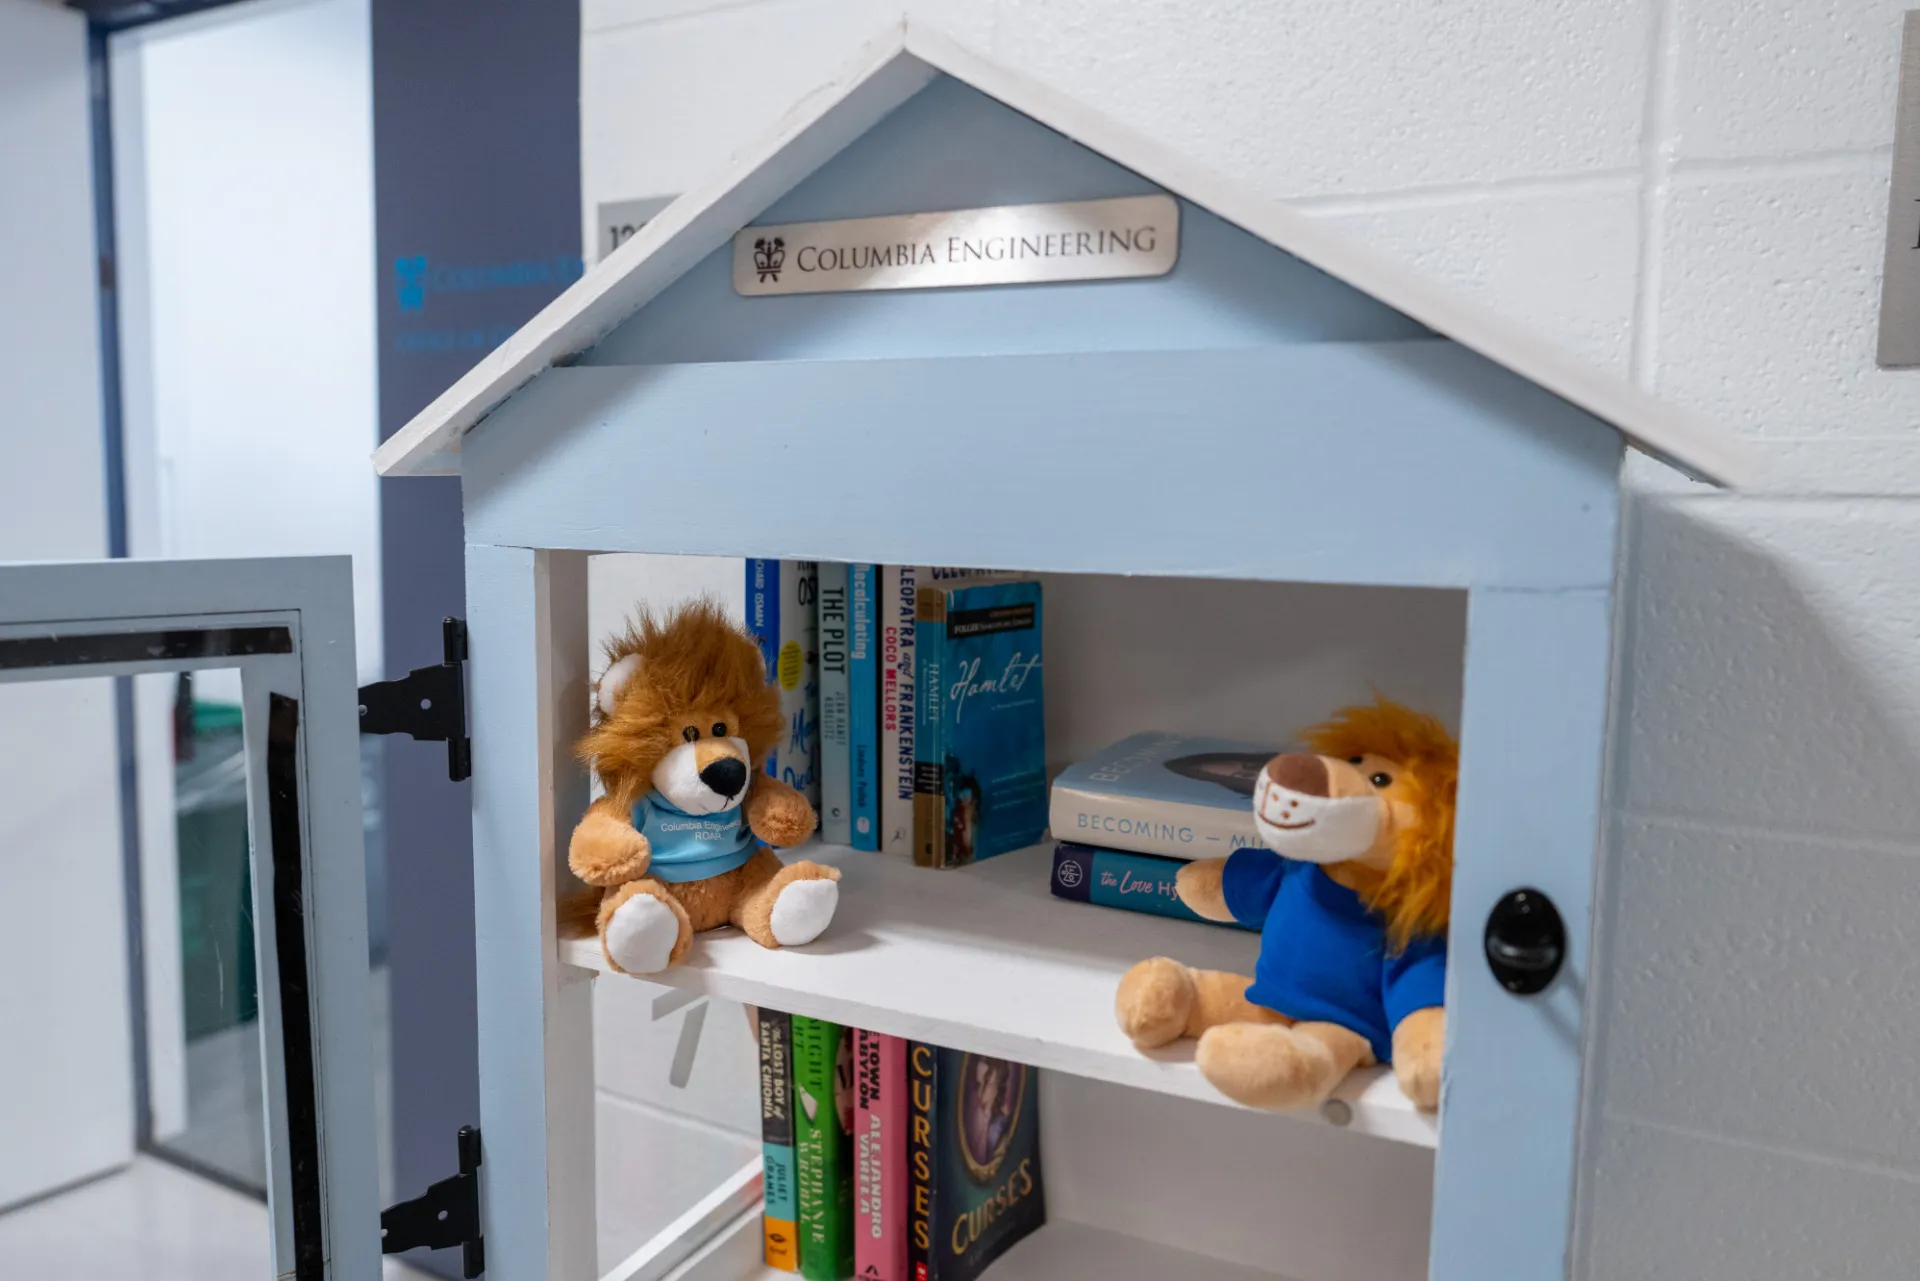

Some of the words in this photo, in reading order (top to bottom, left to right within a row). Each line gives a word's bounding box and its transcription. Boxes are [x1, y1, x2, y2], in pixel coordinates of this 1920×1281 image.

[796, 242, 935, 273] COLUMBIA
[948, 225, 1156, 264] ENGINEERING
[822, 586, 845, 623] THE
[899, 566, 915, 648] LEOPATRA
[822, 629, 846, 675] PLOT
[885, 626, 897, 663] COCO
[898, 652, 914, 680] and
[885, 668, 897, 731] MELLORS
[929, 663, 940, 722] HAMLET
[950, 652, 1042, 723] Hamlet
[898, 684, 914, 800] FRANKENSTEIN
[660, 820, 703, 832] Columbia
[1077, 813, 1194, 843] BECOMING
[1101, 871, 1117, 886] the
[1119, 870, 1154, 894] Love
[761, 1021, 772, 1061] SANTA
[773, 1042, 784, 1075] LOST
[762, 1065, 773, 1119] CHIONIA
[773, 1078, 785, 1104] BOY
[869, 1041, 881, 1101] TOWN
[772, 1105, 785, 1120] of
[859, 1133, 870, 1214] VARELA
[912, 1046, 931, 1250] CURSES
[776, 1163, 787, 1201] JULIET
[799, 1142, 811, 1224] WROBEL
[809, 1128, 825, 1243] STEPHANIE
[870, 1113, 882, 1239] ALEJANDRO
[952, 1158, 1033, 1255] CURSES
